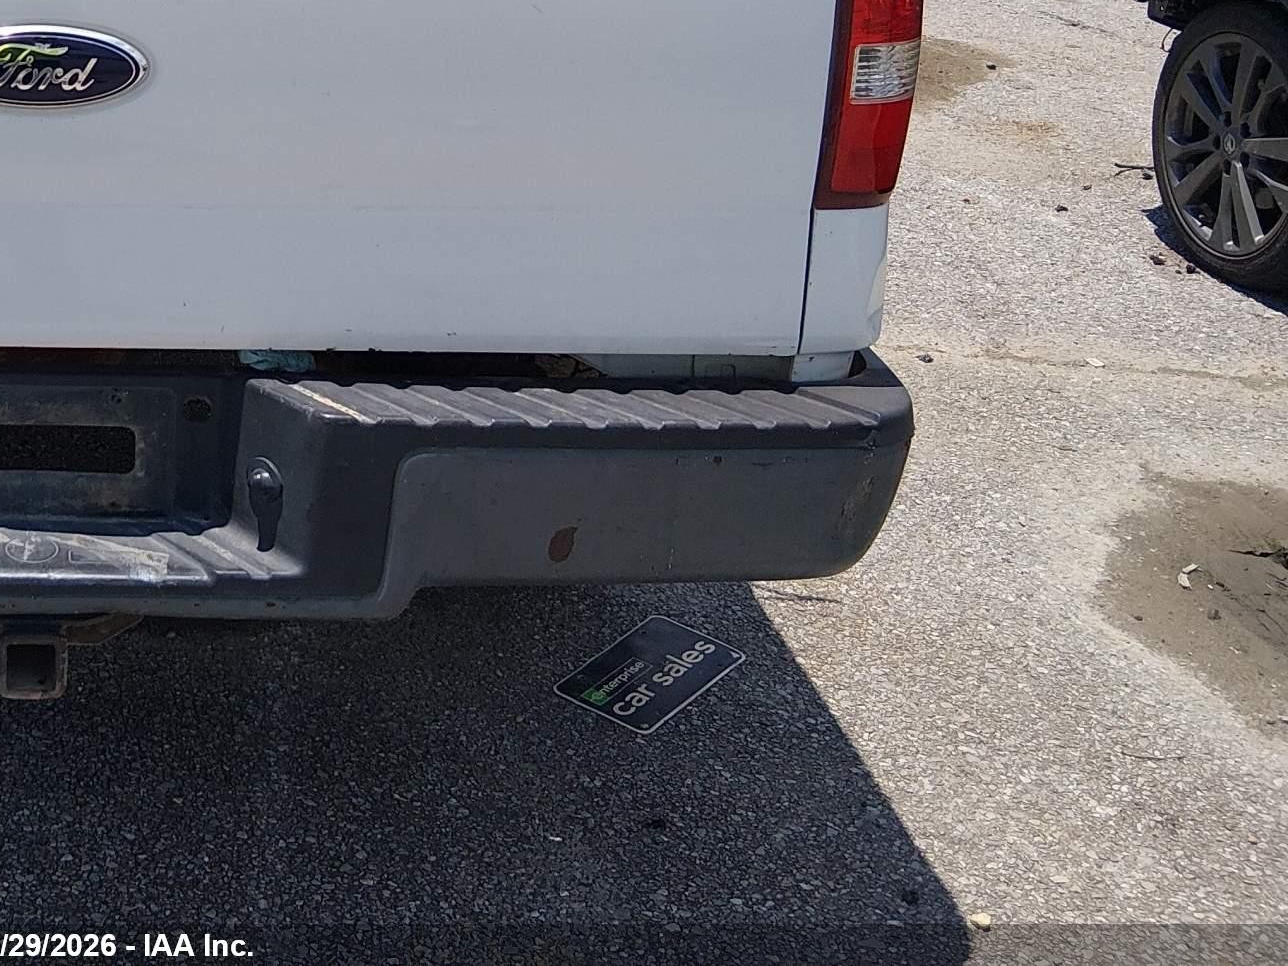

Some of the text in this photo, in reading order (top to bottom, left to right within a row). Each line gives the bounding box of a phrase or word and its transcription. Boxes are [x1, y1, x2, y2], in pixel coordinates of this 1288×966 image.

[590, 661, 645, 701] enterprise
[612, 640, 716, 716] car sales
